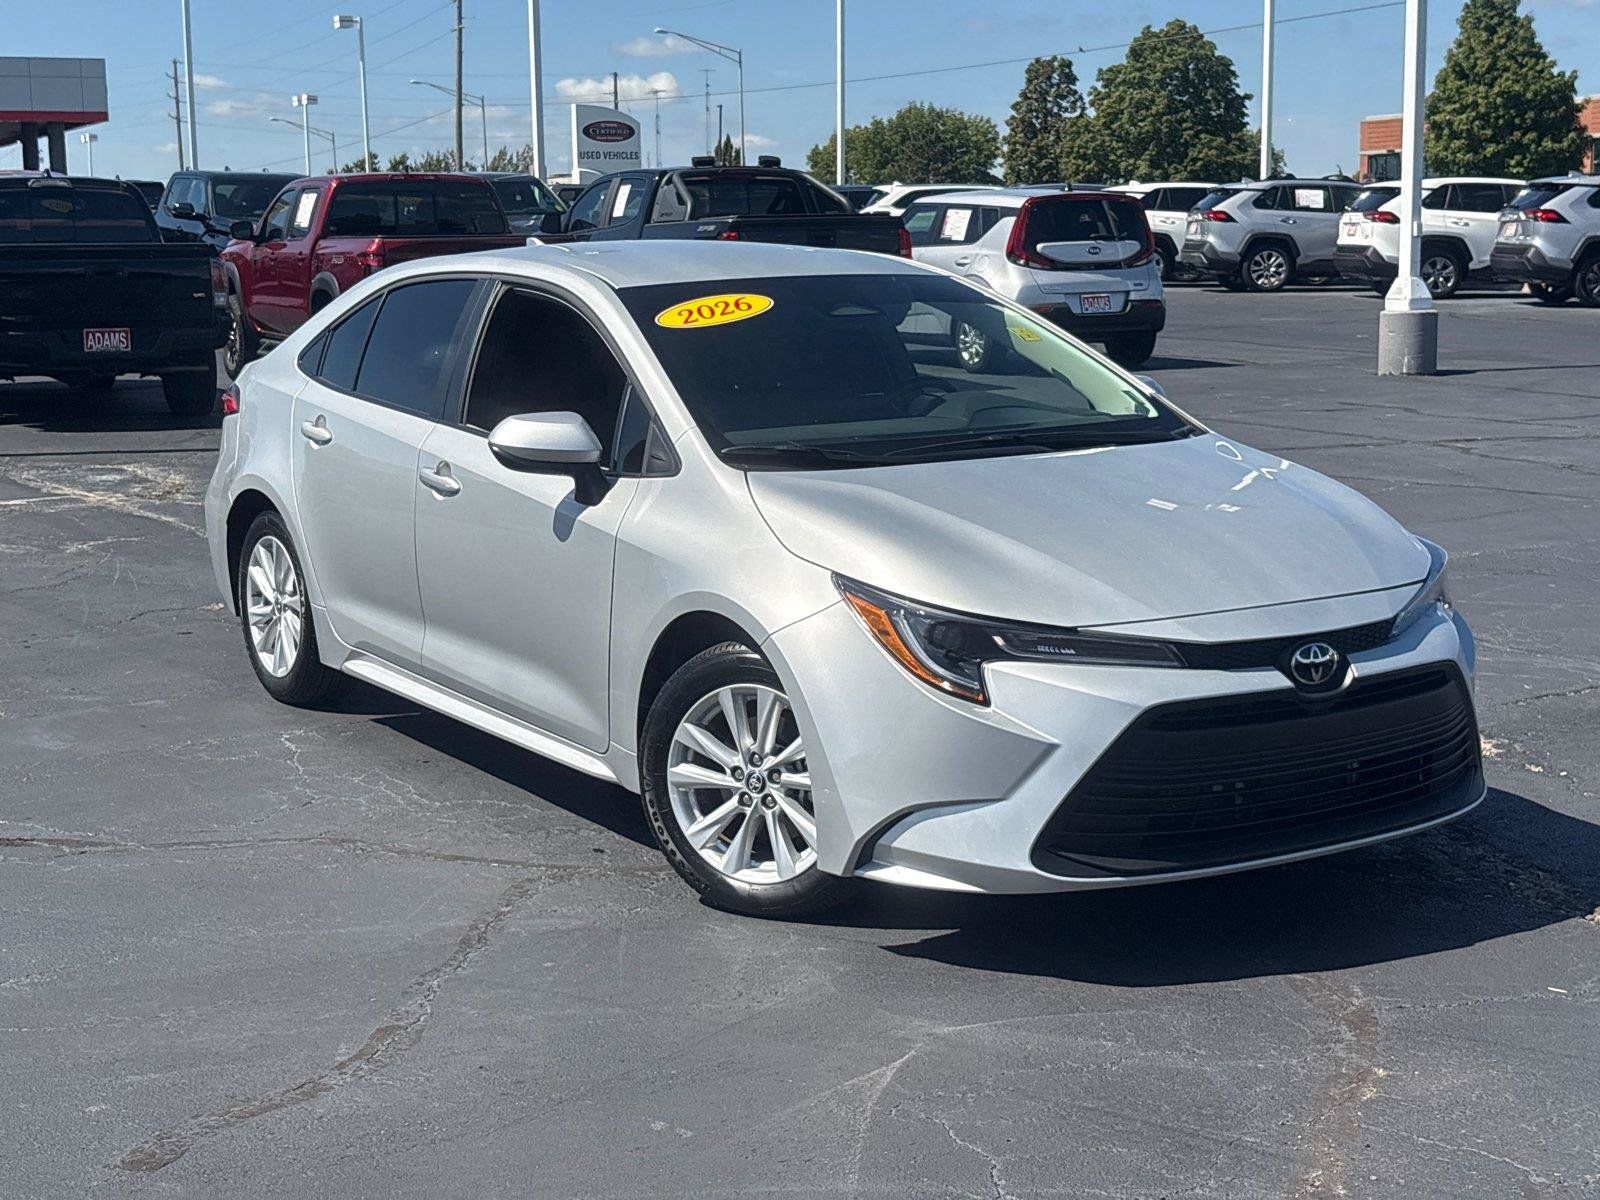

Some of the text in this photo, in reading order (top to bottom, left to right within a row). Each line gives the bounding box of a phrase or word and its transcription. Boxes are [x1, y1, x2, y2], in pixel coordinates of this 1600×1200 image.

[580, 151, 640, 160] USED VEHICLES
[677, 297, 752, 325] 2026
[1083, 297, 1110, 310] ADAMS
[87, 332, 127, 349] ADAMS
